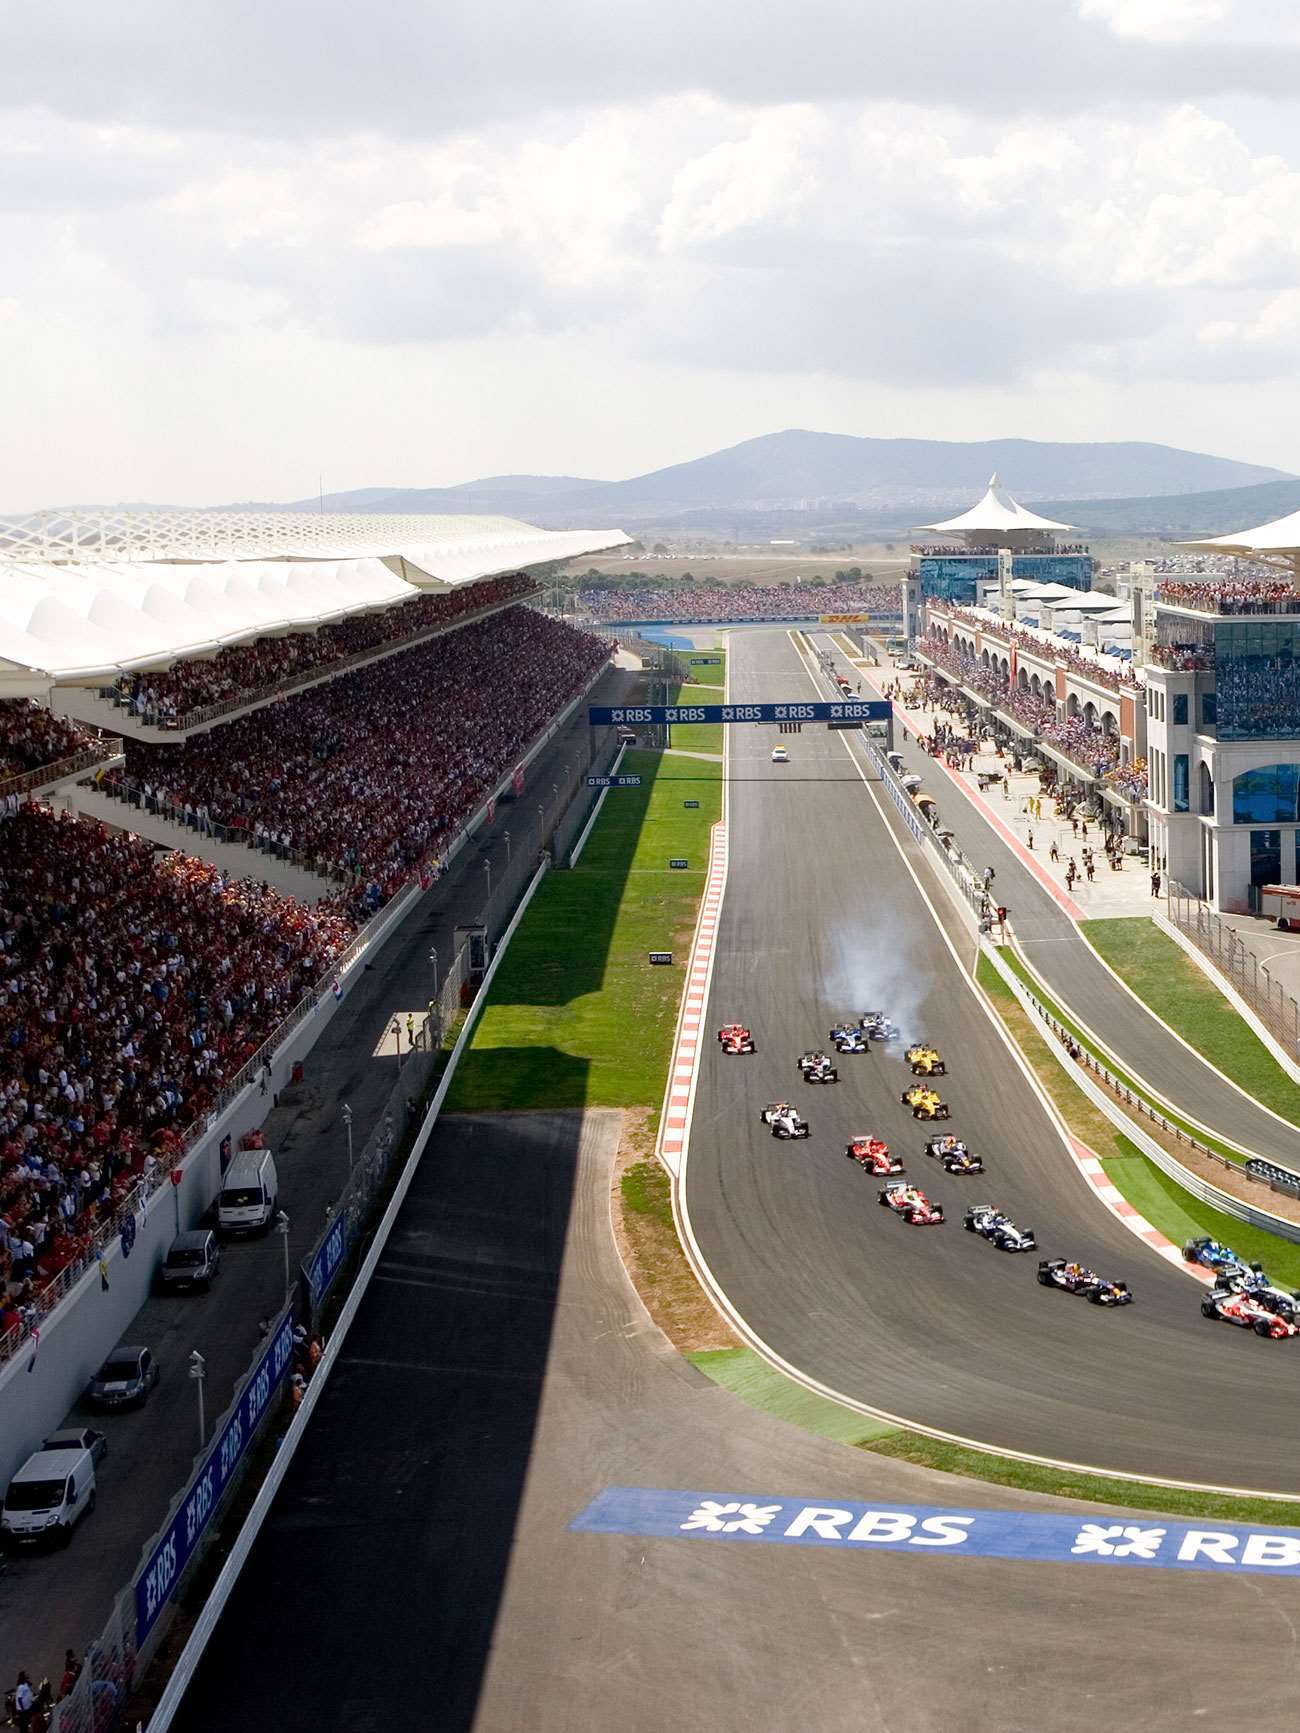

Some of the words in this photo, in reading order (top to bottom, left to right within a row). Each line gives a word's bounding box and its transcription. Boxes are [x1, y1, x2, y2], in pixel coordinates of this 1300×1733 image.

[828, 615, 862, 623] DHL
[626, 709, 652, 721] RBS
[680, 708, 706, 720] RBS
[736, 707, 762, 719] RBS
[789, 705, 815, 718] RBS
[845, 704, 870, 717] RBS
[626, 777, 640, 785] RBS
[156, 1530, 177, 1602] RBS
[196, 1465, 213, 1525] RBS
[228, 1409, 242, 1470] RBS
[784, 1506, 975, 1547] RBS
